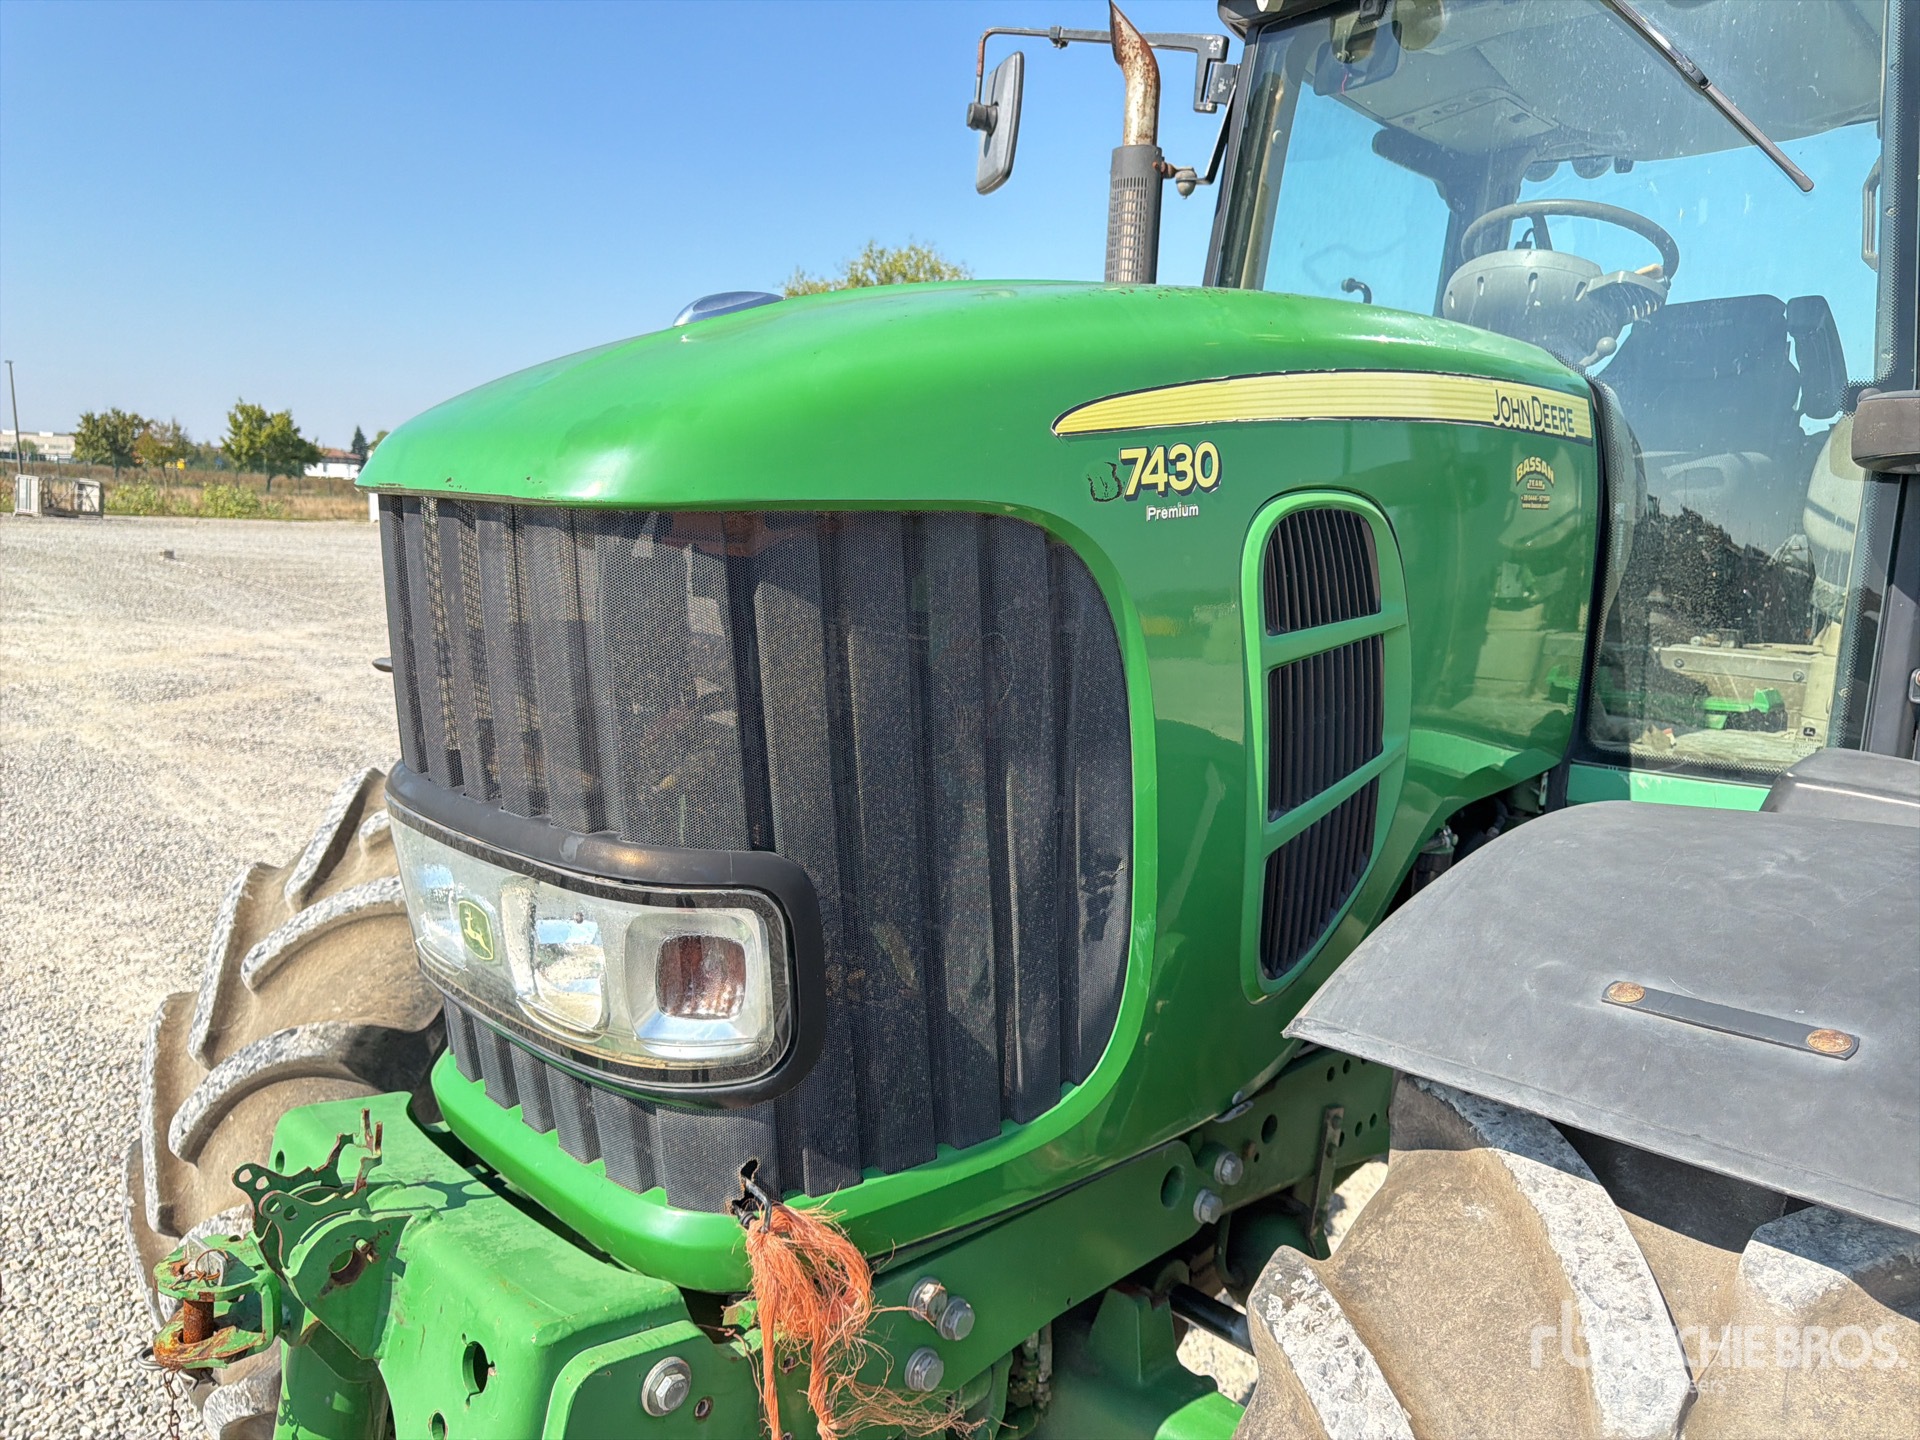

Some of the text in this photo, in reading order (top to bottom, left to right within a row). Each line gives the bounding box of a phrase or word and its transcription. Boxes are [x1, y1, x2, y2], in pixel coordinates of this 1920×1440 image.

[1493, 389, 1575, 433] JOHN DEERE
[1119, 441, 1222, 501] 7430
[1146, 502, 1199, 521] Premium
